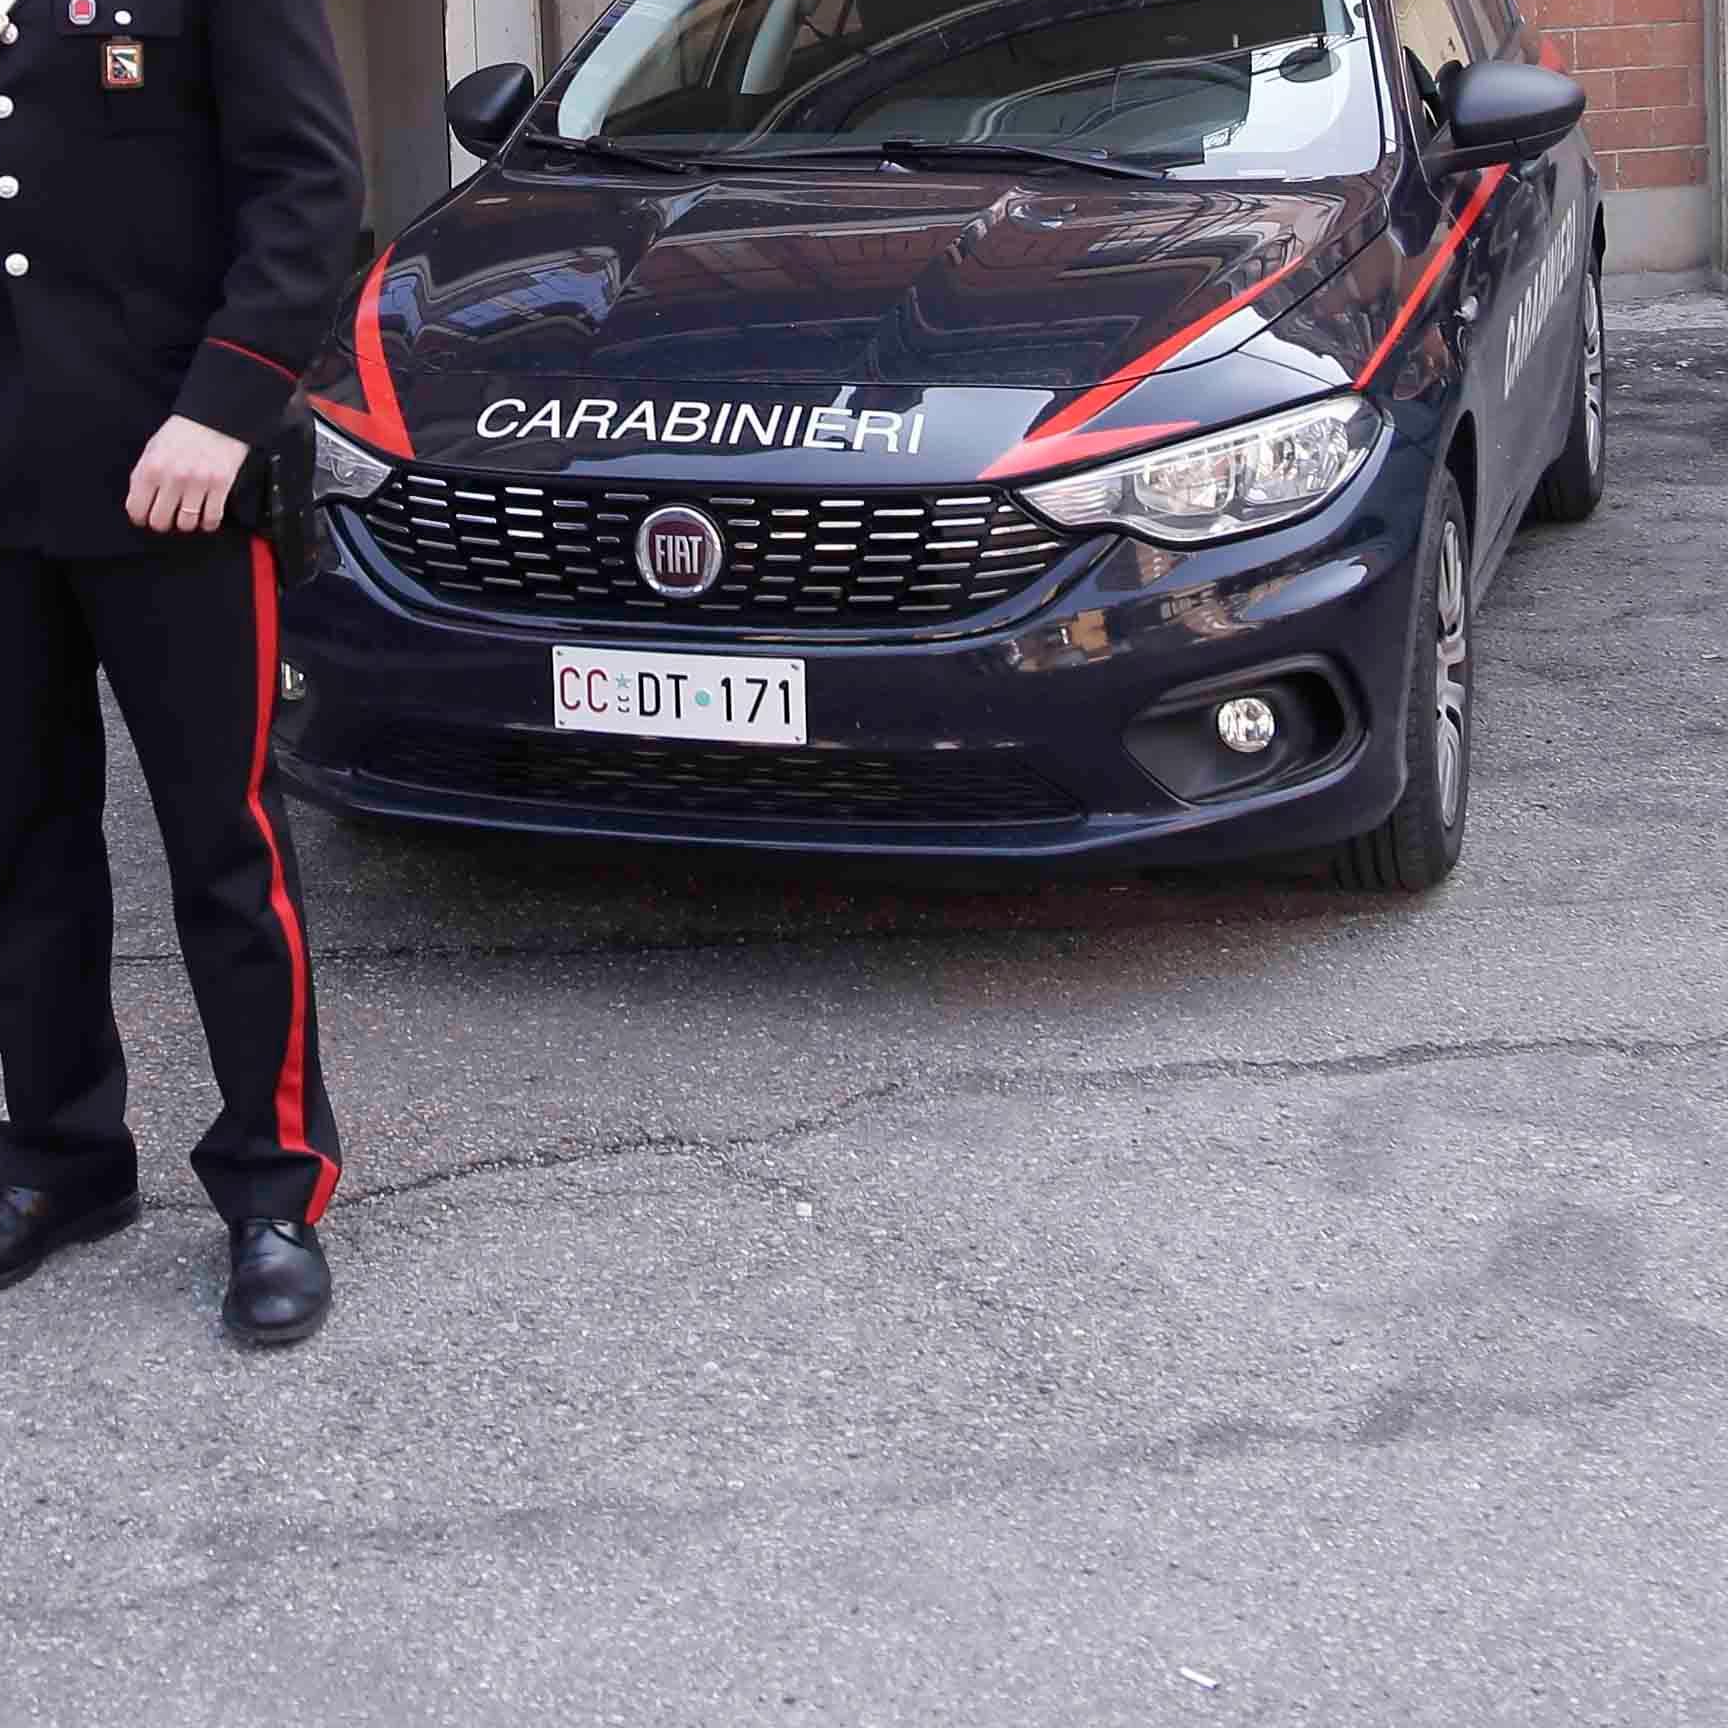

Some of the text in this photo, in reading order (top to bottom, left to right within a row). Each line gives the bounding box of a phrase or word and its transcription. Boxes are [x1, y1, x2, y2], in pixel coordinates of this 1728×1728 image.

[475, 398, 926, 454] CARABINIERI
[654, 534, 703, 575] FIAT
[559, 666, 791, 724] CC DT 171
